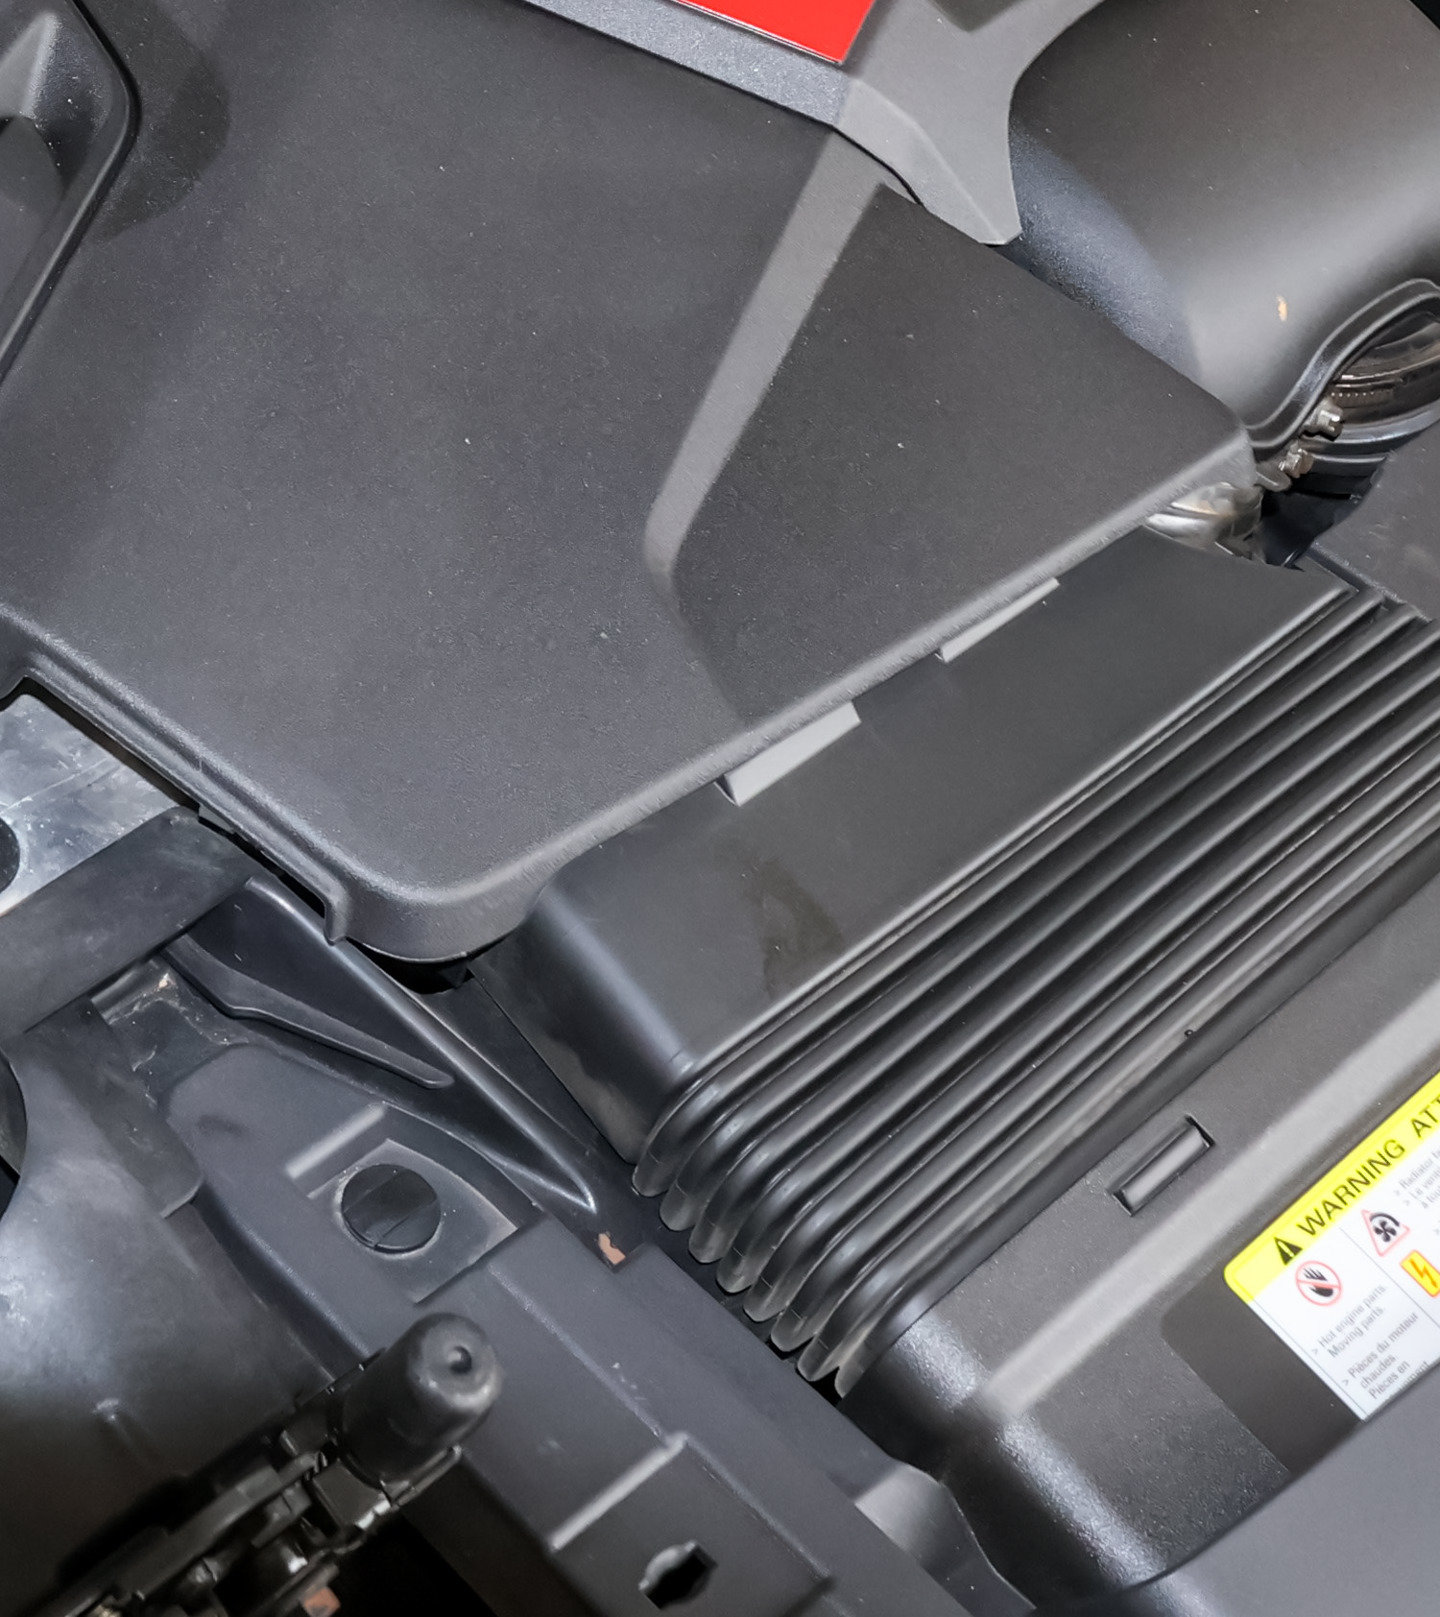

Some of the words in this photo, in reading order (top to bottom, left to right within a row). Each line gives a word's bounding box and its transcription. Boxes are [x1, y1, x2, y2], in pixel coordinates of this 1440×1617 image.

[1296, 1135, 1406, 1239] WARNING
[1317, 1328, 1336, 1347] Hot
[1333, 1302, 1366, 1334] engine
[1327, 1324, 1363, 1359] Moving
[1346, 1348, 1378, 1378] Pièces
[1373, 1337, 1390, 1353] du
[1386, 1311, 1419, 1342] moteur
[1367, 1368, 1399, 1399] Pièces
[1396, 1359, 1410, 1374] en
